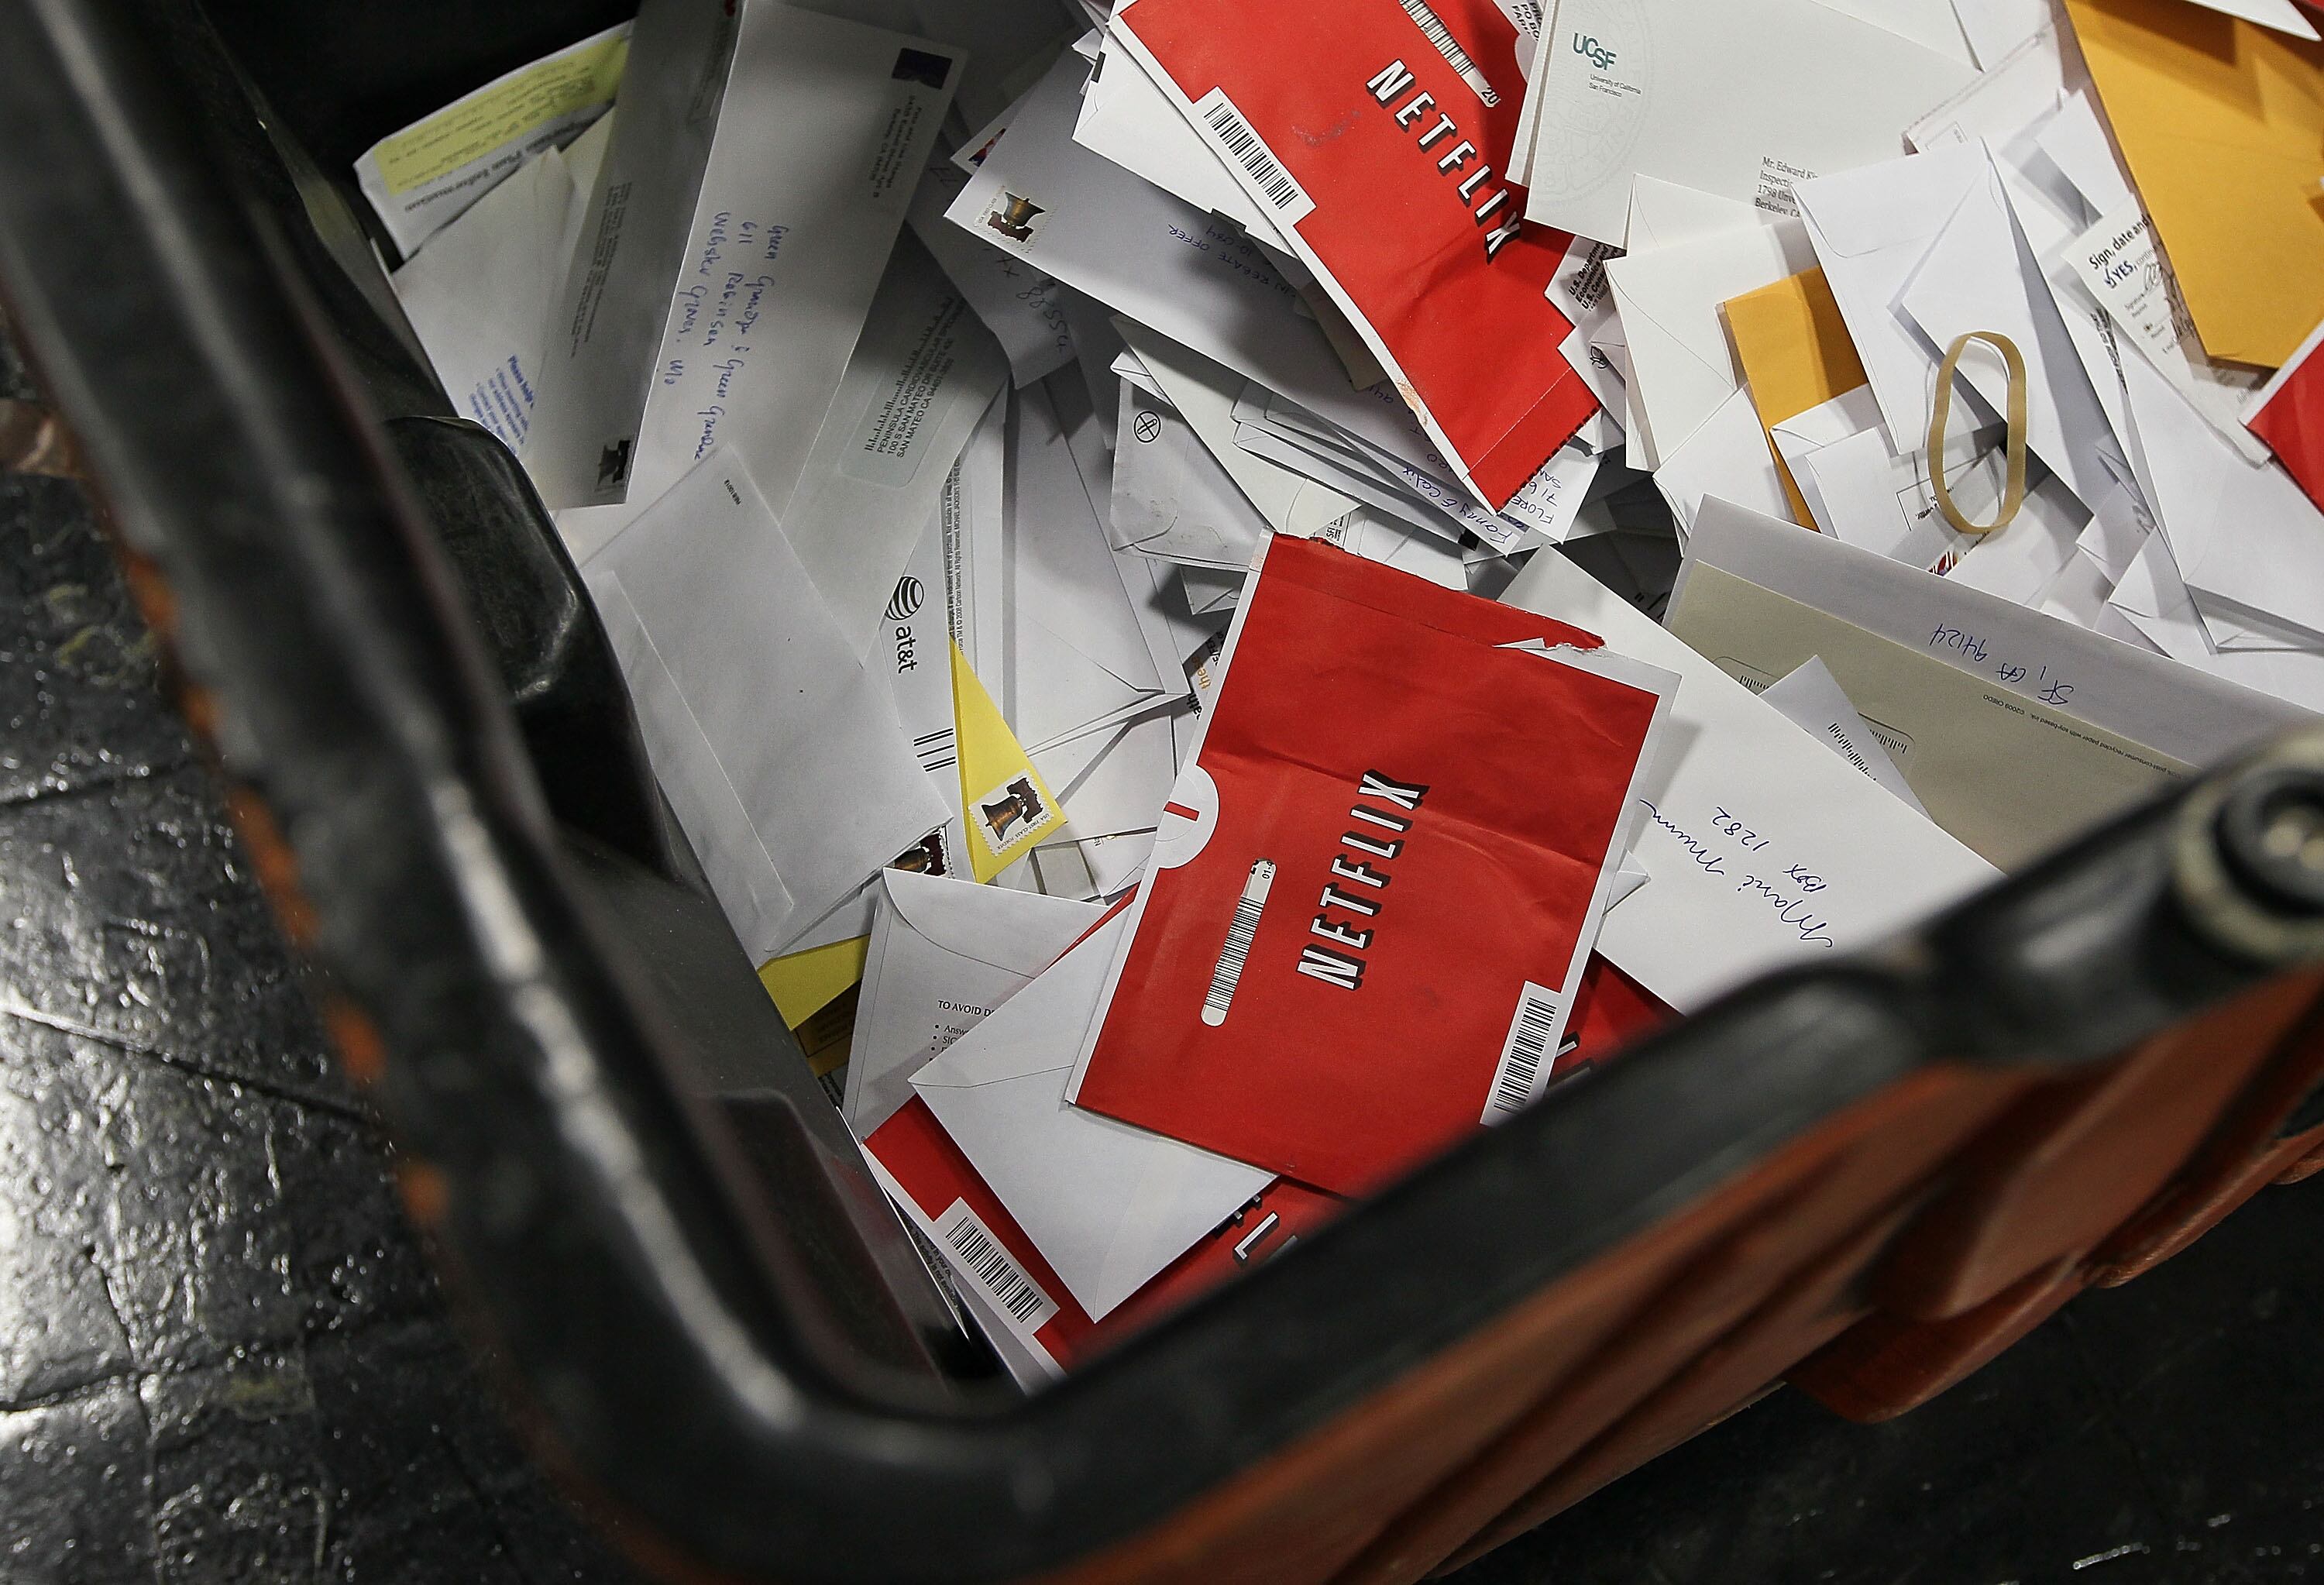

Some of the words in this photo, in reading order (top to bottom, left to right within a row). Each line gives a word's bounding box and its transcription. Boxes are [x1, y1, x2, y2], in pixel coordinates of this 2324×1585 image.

[1573, 32, 1617, 70] UCSF
[1363, 57, 1525, 264] NETFLIX
[1761, 156, 1776, 169] Mr.
[1776, 160, 1805, 177] Edward
[1164, 223, 1211, 253] OFFER
[2087, 243, 2116, 271] Sign,
[2110, 227, 2134, 253] date
[2130, 214, 2150, 236] and
[1568, 277, 1581, 296] U.S.
[1581, 291, 1594, 309] U.S.
[875, 404, 904, 453] PENINSULA
[886, 439, 899, 456] 100
[896, 412, 912, 433] SAN
[905, 383, 927, 414] MATEO
[896, 438, 910, 459] SAN
[904, 407, 925, 440] MATEO
[919, 394, 932, 409] CA
[895, 625, 917, 673] at&t
[1191, 655, 1211, 689] these
[1711, 806, 1769, 851] 1282
[1294, 768, 1430, 990] NETFLIX
[937, 999, 951, 1009] TO
[951, 1002, 982, 1015] AVOID
